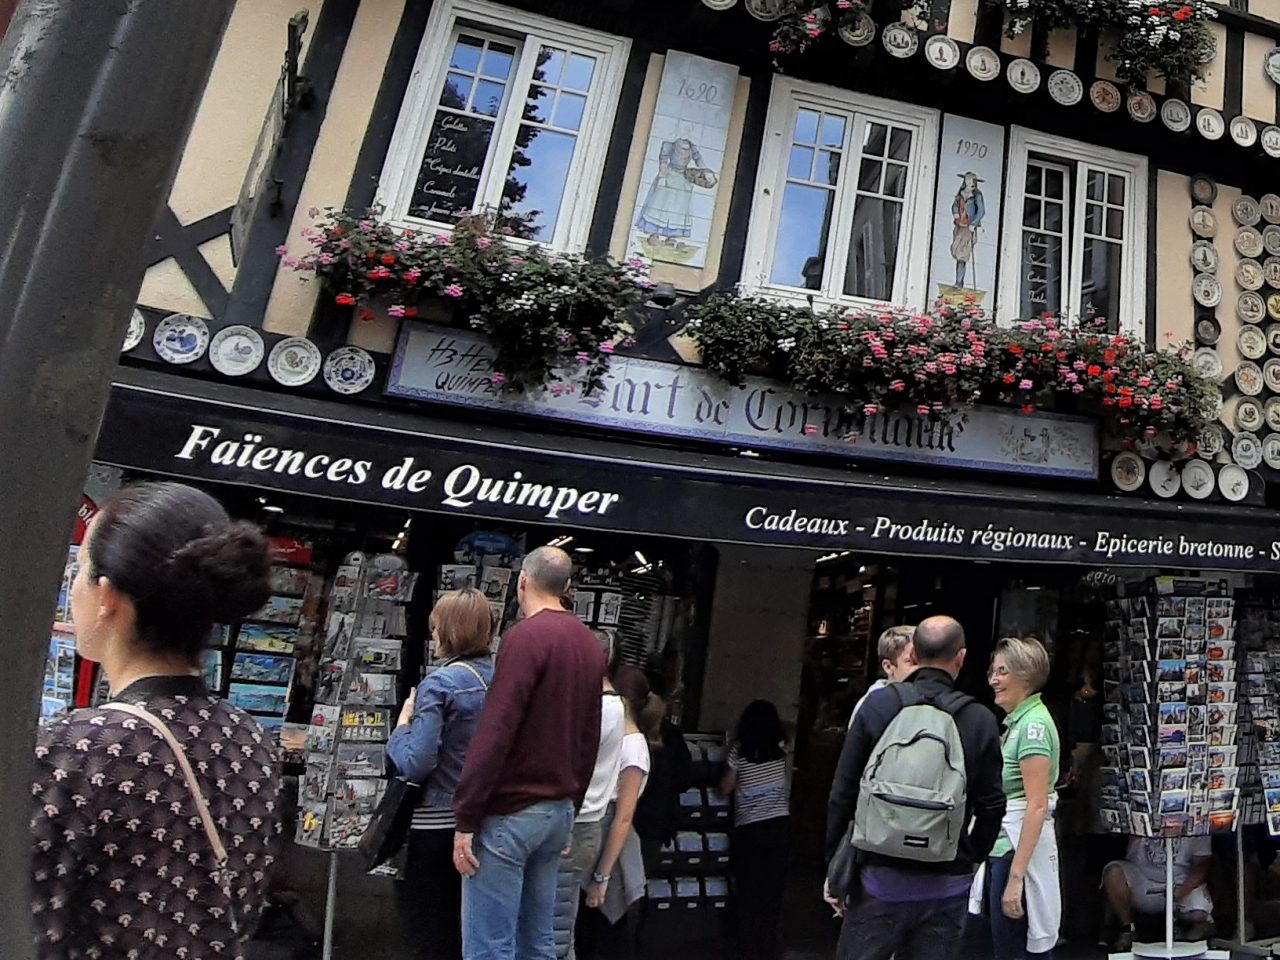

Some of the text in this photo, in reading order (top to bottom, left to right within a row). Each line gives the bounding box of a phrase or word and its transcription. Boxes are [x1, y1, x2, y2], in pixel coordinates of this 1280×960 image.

[678, 79, 718, 104] 1690
[956, 139, 988, 159] 1990
[694, 389, 730, 426] de
[174, 424, 620, 519] Faïences de Quimper
[745, 506, 848, 536] Cadeaux
[871, 516, 964, 544] Produits
[971, 524, 1073, 551] régionaux
[1094, 531, 1173, 558] Epicerie
[1179, 536, 1254, 559] bretonne
